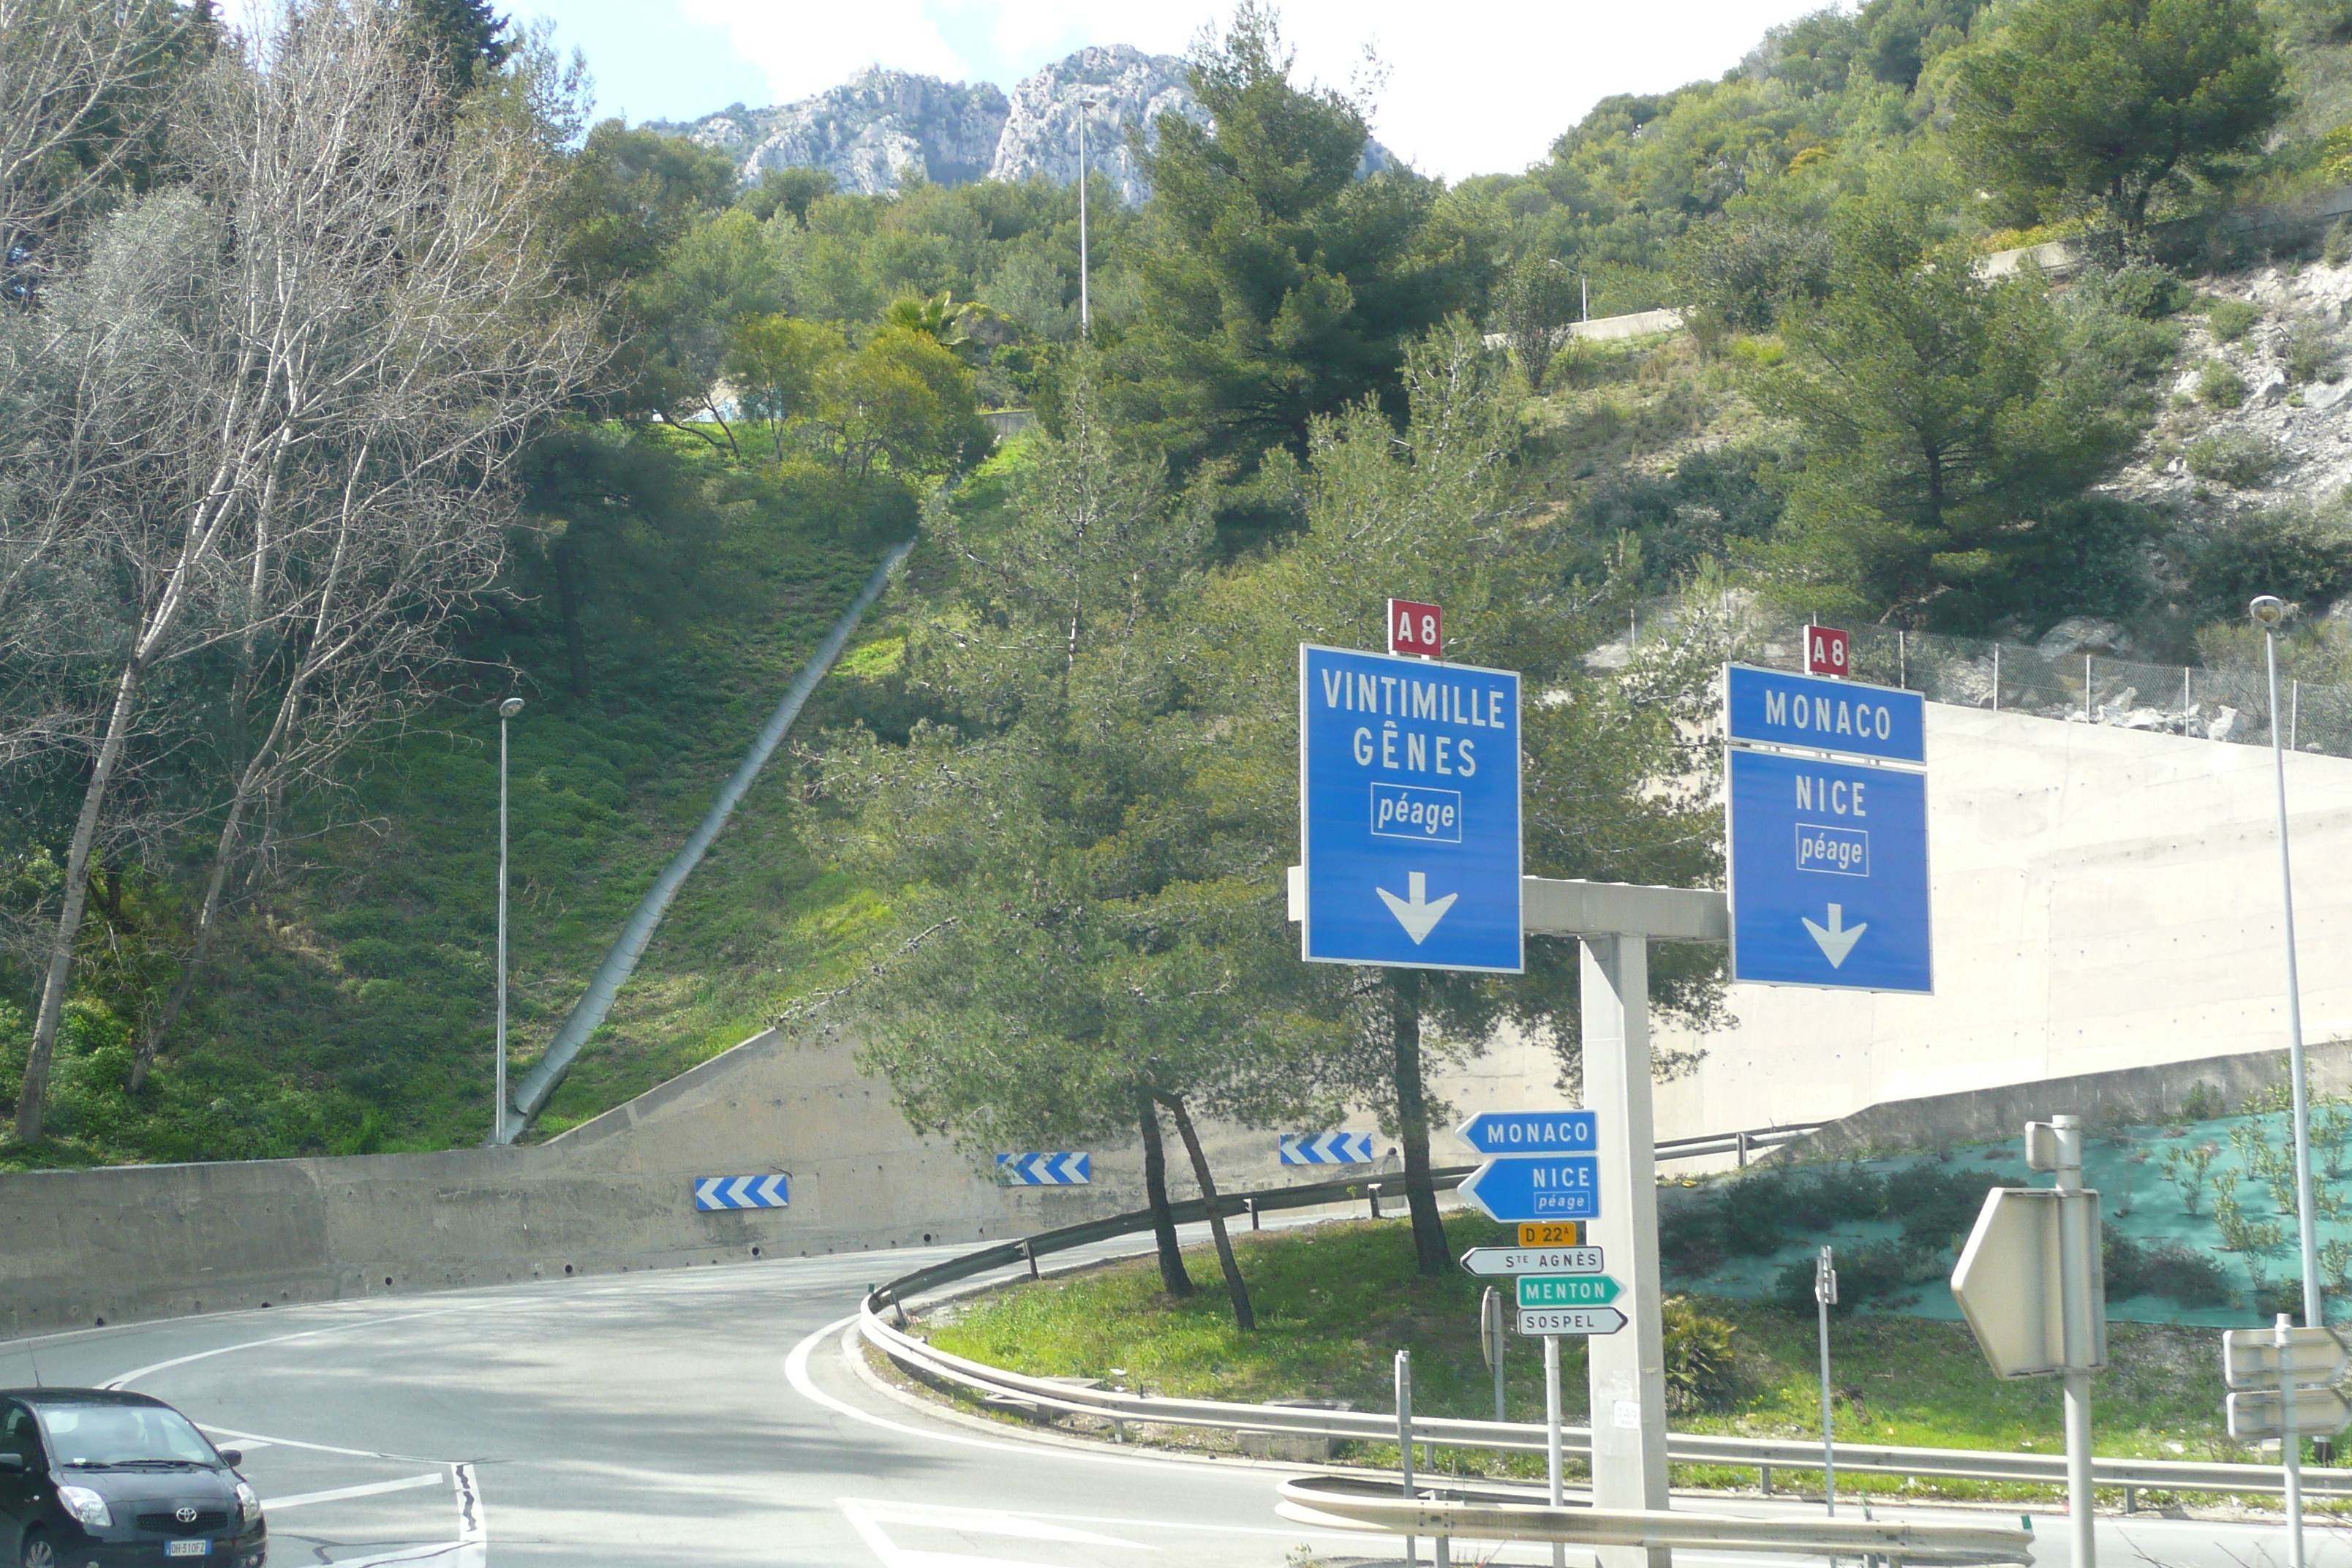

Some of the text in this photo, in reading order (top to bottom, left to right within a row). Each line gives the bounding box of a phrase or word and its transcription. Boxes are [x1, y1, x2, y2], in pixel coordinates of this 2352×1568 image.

[1322, 668, 1505, 728] VINTIMILLE
[1765, 690, 1891, 741] MONACO
[1354, 720, 1476, 777] GÊNES
[1796, 774, 1866, 817] NICE
[1378, 792, 1455, 834] péage
[1801, 832, 1862, 870] péage
[1488, 1122, 1588, 1143] MONACO
[1533, 1167, 1590, 1188] NICE
[1539, 1194, 1585, 1210] péage
[1539, 1251, 1597, 1267] AGNÈS
[1526, 1282, 1605, 1300] MENTON
[1526, 1315, 1594, 1329] SOSPEL
